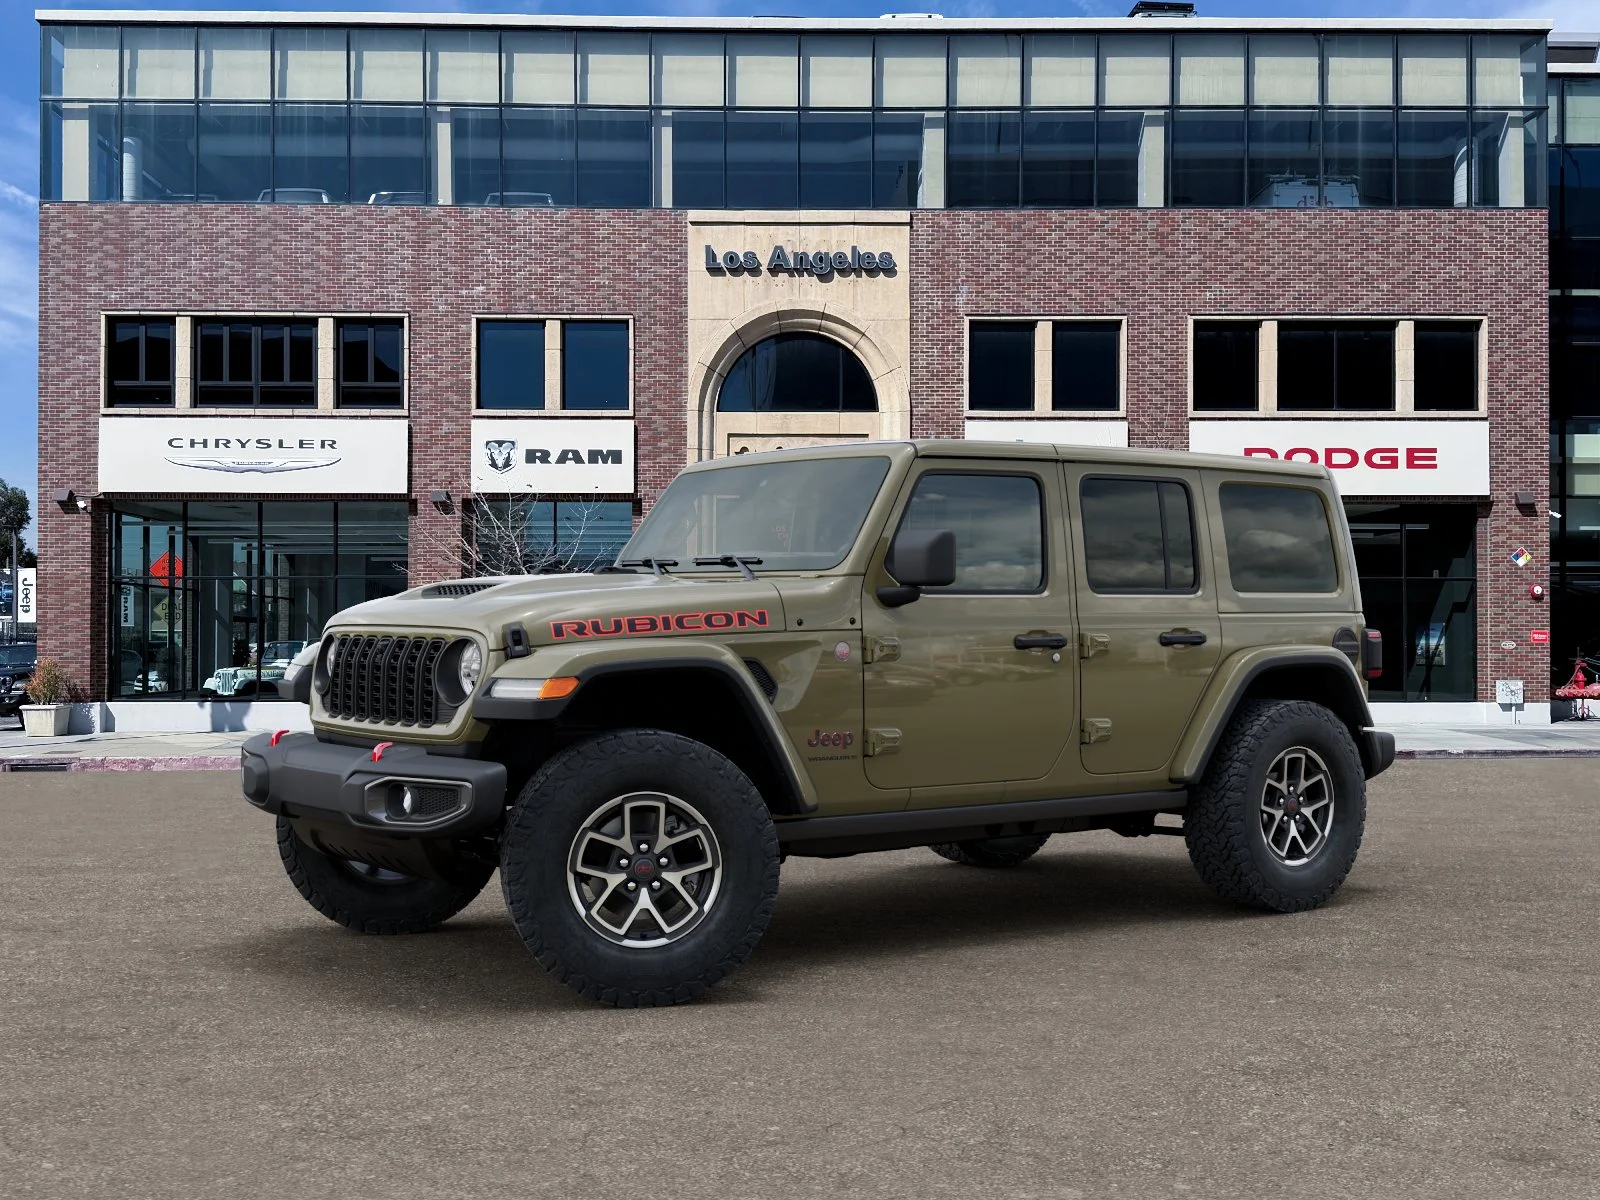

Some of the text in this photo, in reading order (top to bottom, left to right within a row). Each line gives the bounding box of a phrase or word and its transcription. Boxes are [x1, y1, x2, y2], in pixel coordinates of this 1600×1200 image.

[705, 245, 895, 275] Los Angeles
[167, 437, 338, 450] CHRYSLER
[525, 448, 623, 465] RAM
[20, 577, 34, 614] Jeep
[551, 609, 769, 640] RUBICON
[807, 729, 854, 752] Jeep
